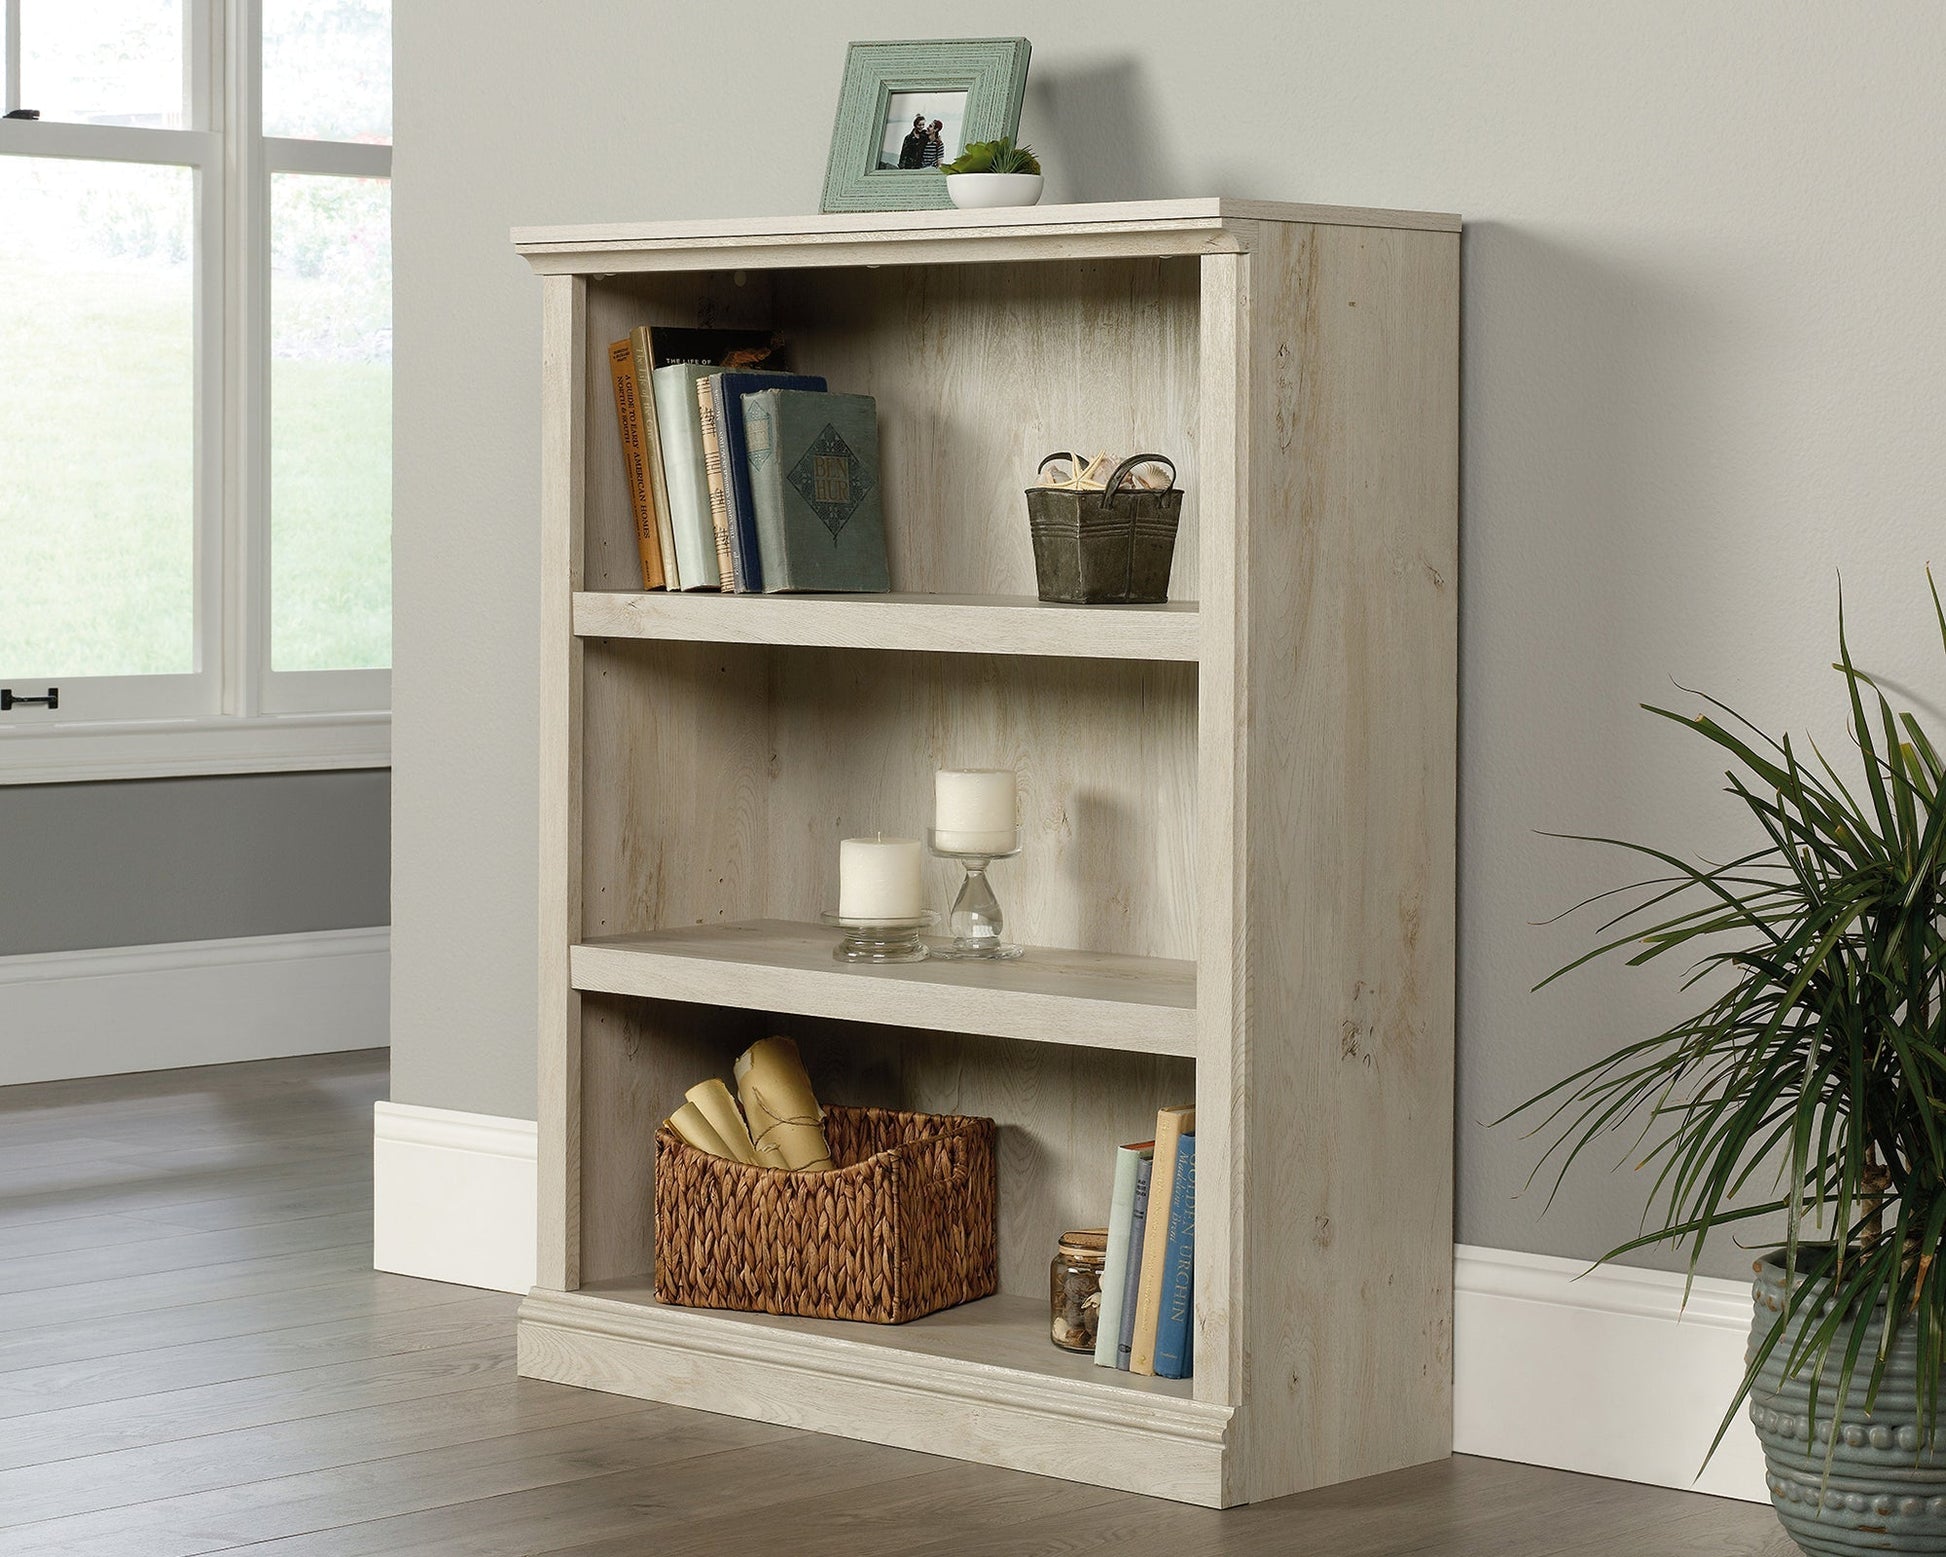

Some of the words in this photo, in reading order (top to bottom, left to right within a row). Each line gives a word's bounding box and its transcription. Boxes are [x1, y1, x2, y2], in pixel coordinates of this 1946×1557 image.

[617, 376, 626, 405] NORTH
[626, 382, 635, 408] GUIDE
[620, 406, 627, 414] &
[628, 410, 636, 422] TO
[622, 415, 630, 443] SOUTH
[634, 452, 646, 501] AMERICAN
[815, 456, 848, 477] BEN
[816, 479, 849, 500] HUR
[641, 505, 650, 539] HOMES
[1173, 1150, 1189, 1208] Madeleine
[1169, 1212, 1181, 1243] Brent
[1170, 1244, 1194, 1324] URCHIN
